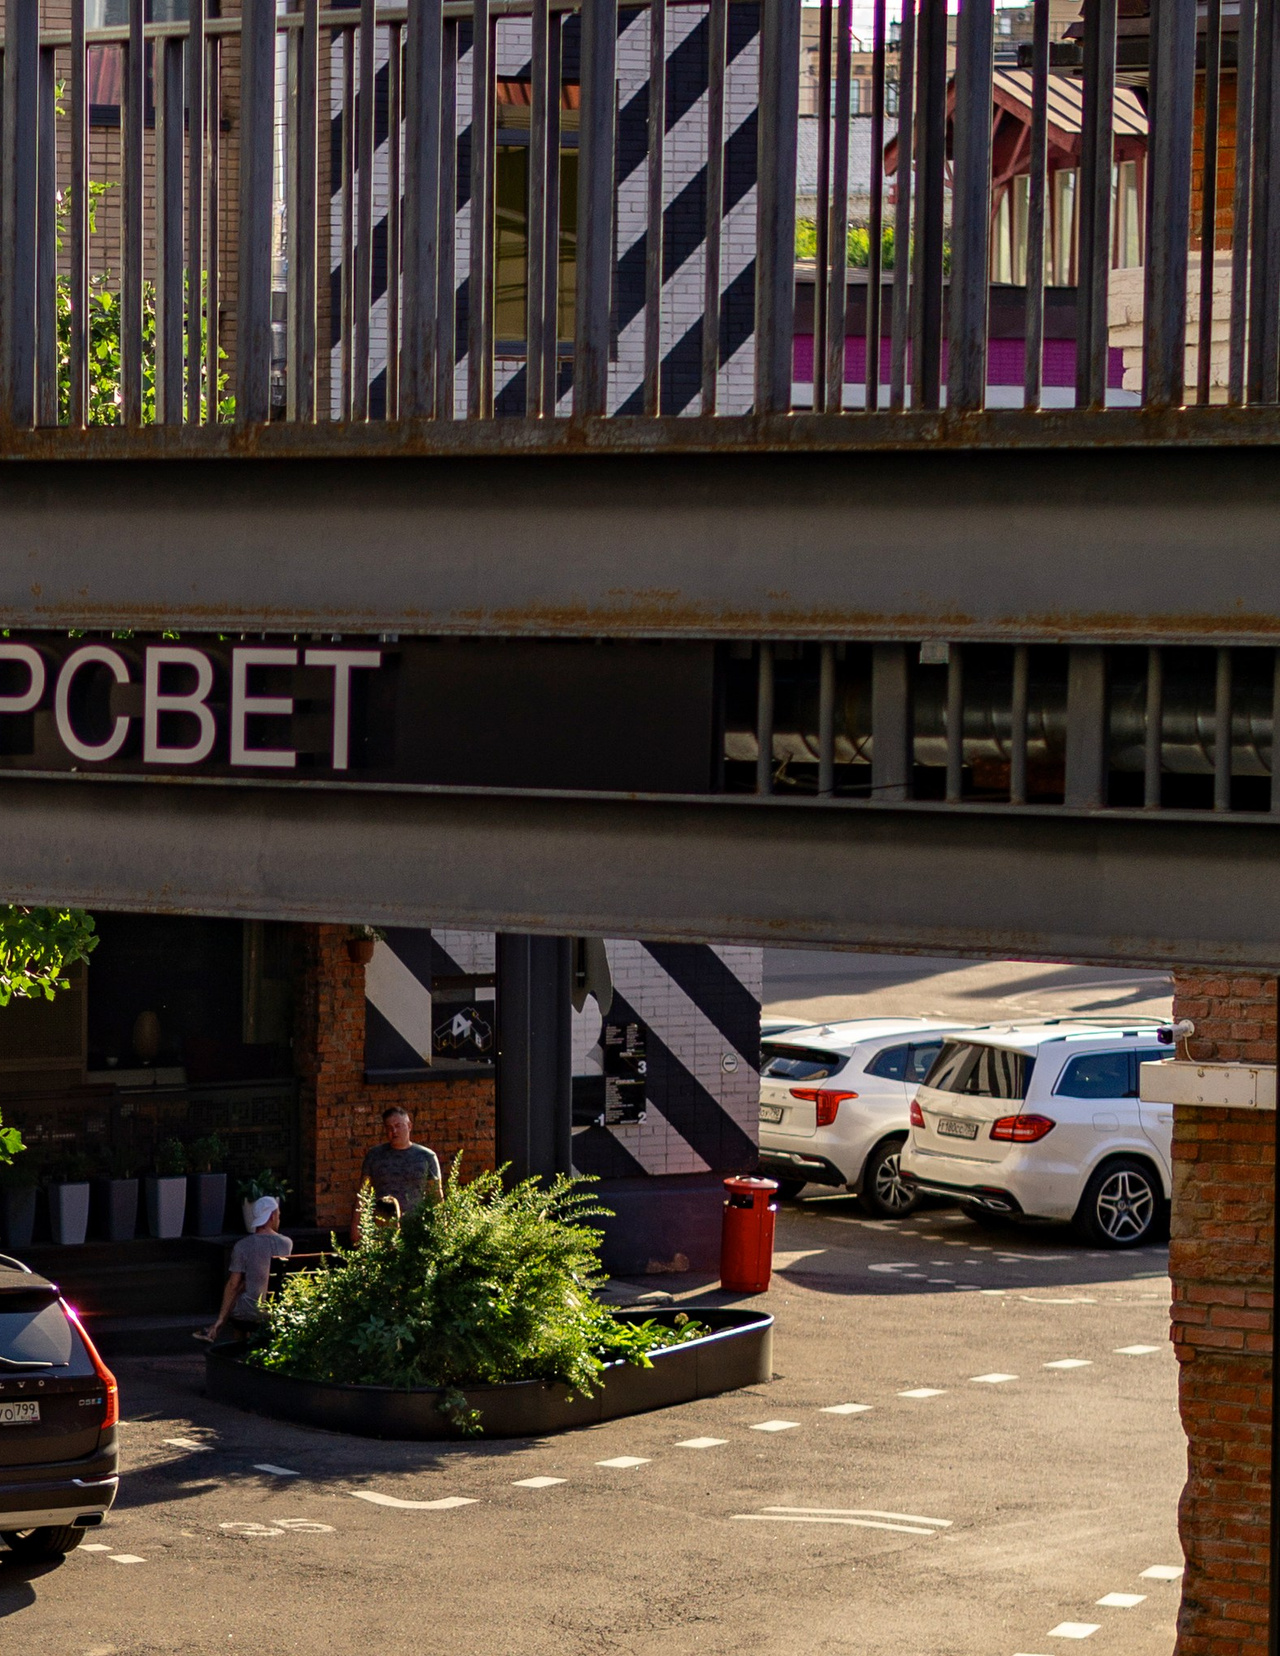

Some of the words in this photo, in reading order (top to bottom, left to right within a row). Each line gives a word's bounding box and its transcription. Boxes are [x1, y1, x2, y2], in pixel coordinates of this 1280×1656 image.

[637, 1060, 647, 1074] 3
[637, 1111, 647, 1124] 2
[218, 1518, 337, 1536] 35
